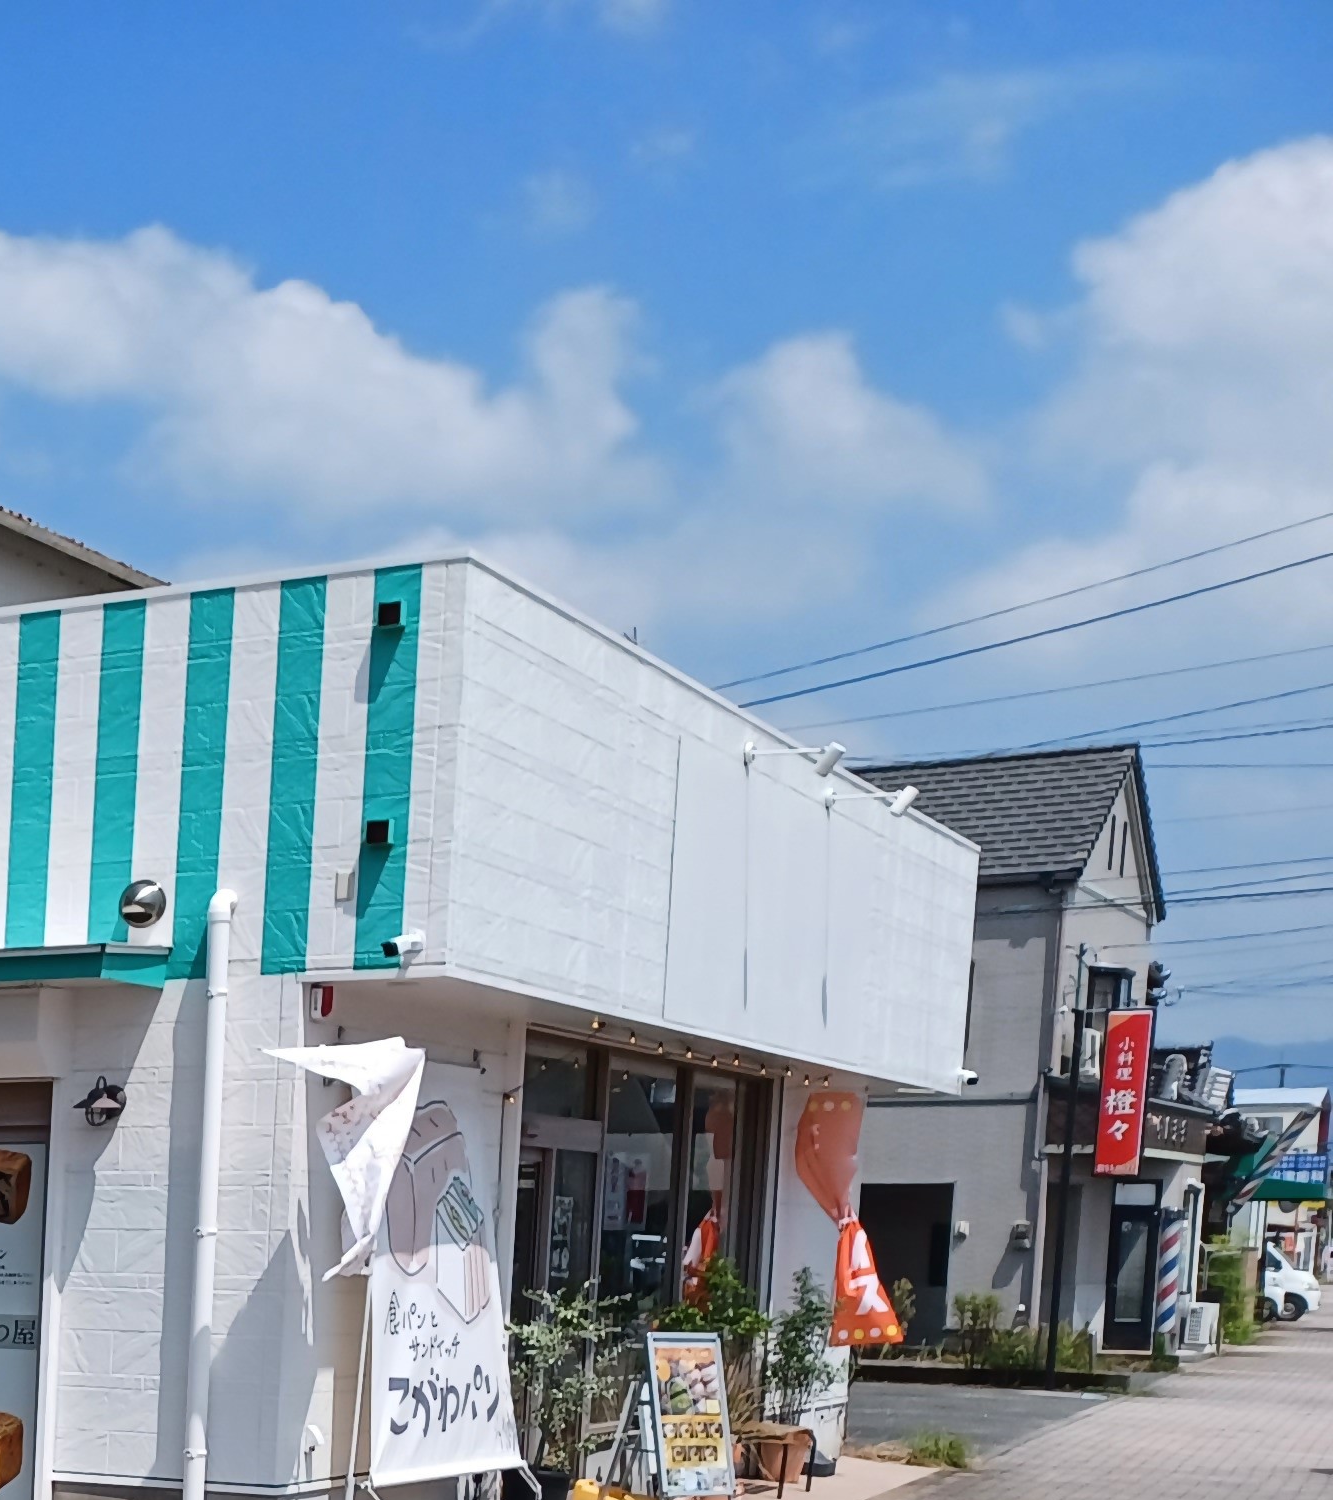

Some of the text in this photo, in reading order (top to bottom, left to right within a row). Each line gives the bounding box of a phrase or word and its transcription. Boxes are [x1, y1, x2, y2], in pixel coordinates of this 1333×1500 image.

[1115, 1036, 1135, 1081] 小料理
[1105, 1088, 1138, 1141] 橙々
[383, 1289, 439, 1335] 食パンと
[408, 1333, 461, 1362] サンドイッチ
[388, 1364, 500, 1438] こがわパン
